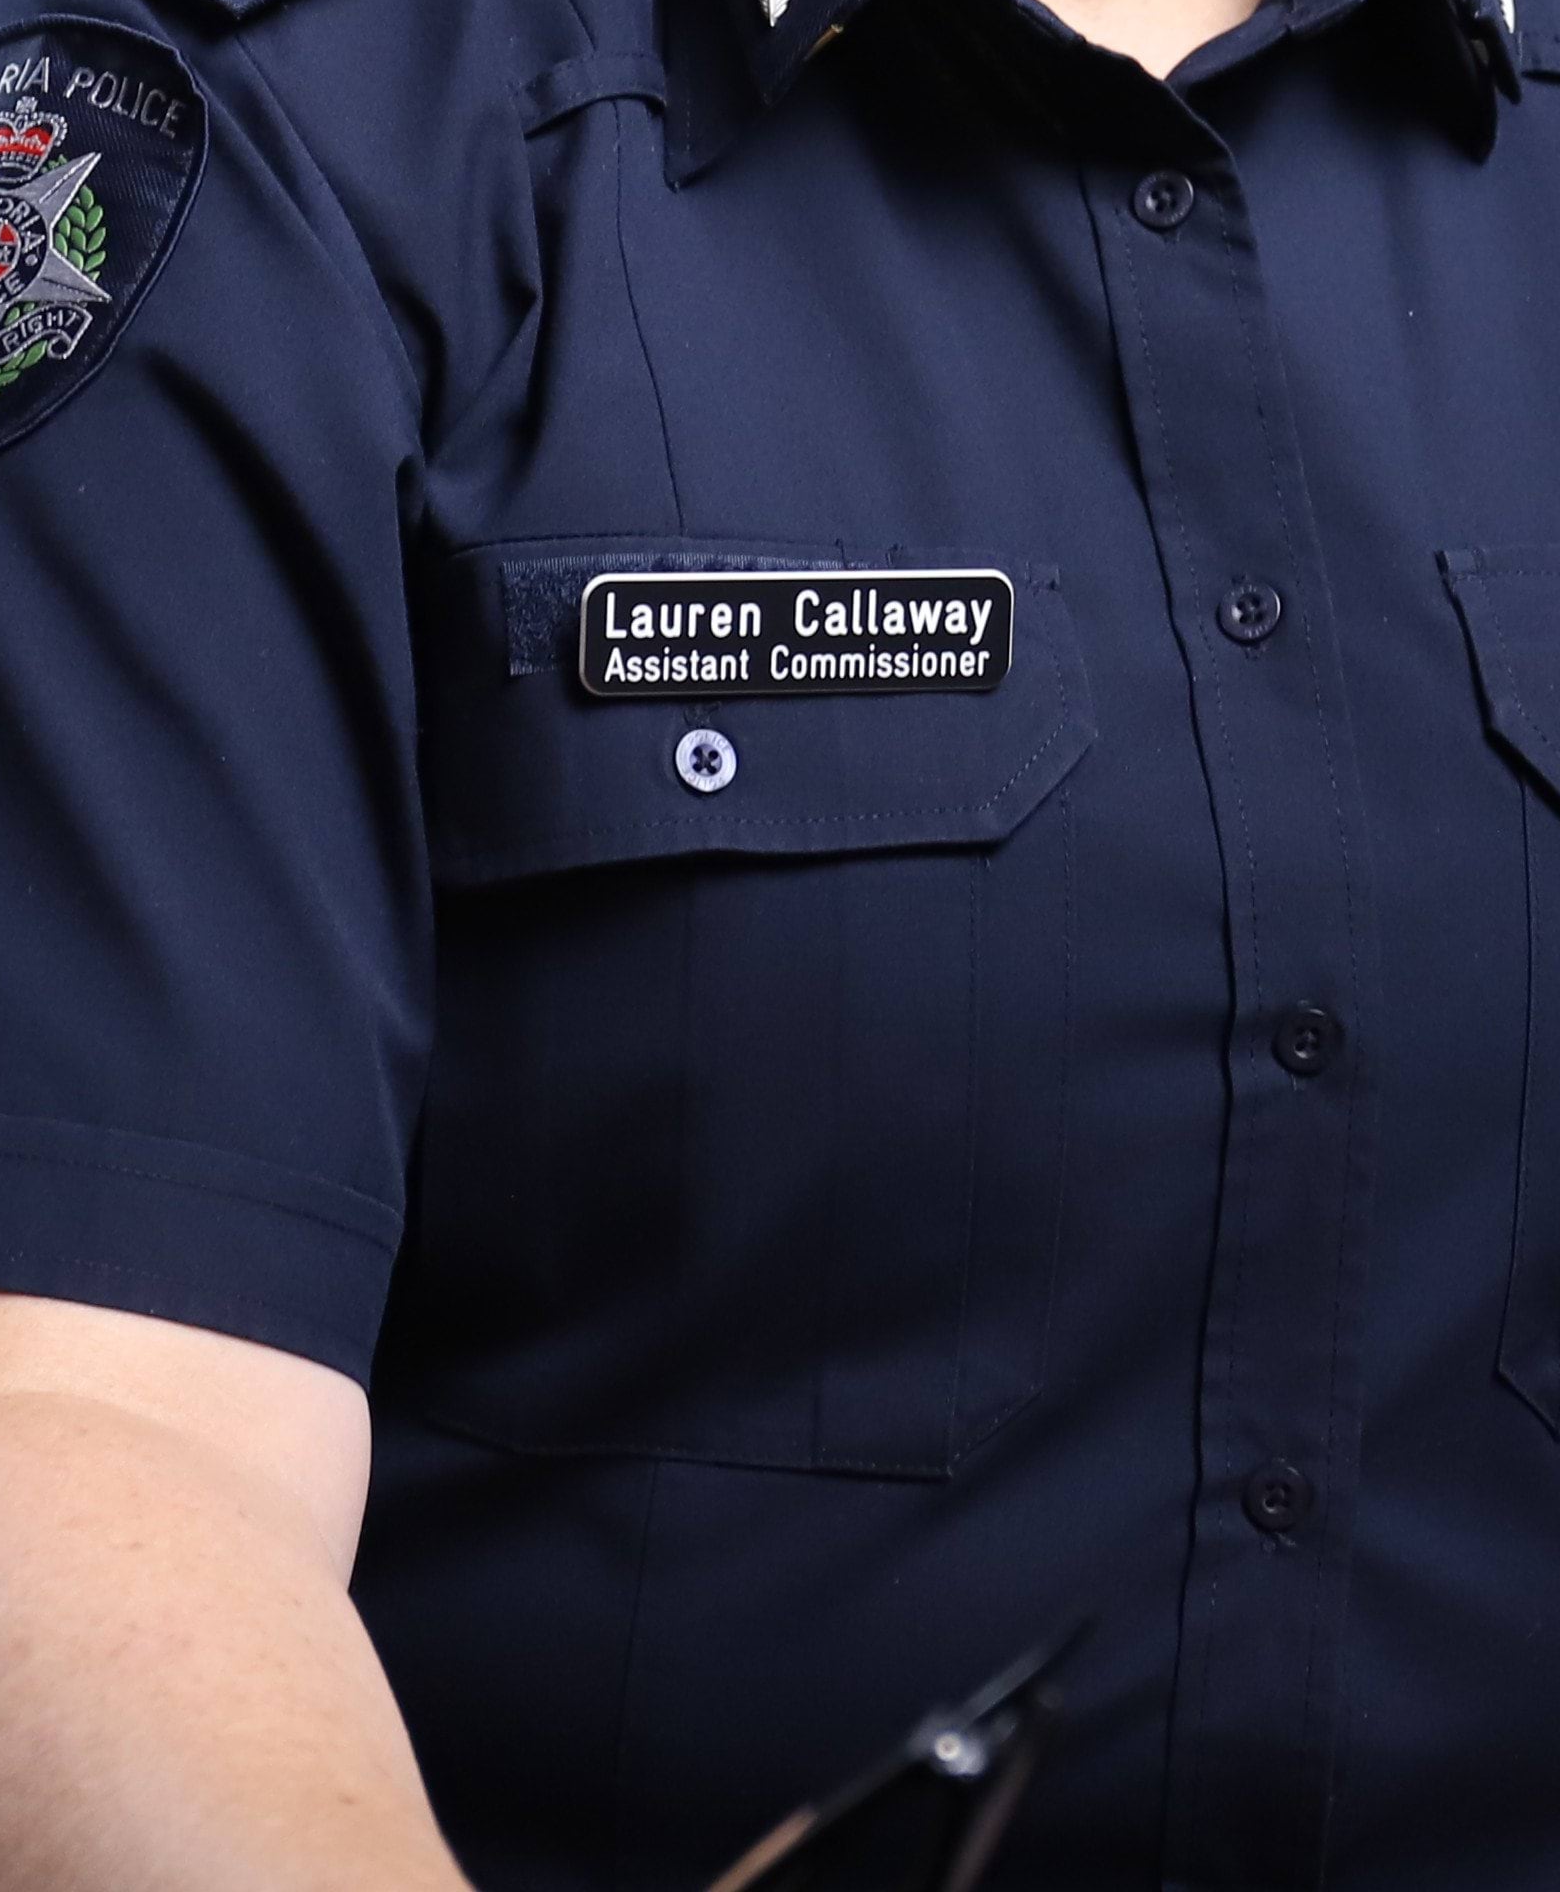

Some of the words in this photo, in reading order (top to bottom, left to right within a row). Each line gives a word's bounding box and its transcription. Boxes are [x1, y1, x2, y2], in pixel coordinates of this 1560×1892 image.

[64, 65, 188, 140] POLICE
[2, 309, 82, 354] RIGHT
[604, 591, 762, 640] Lauren
[793, 588, 993, 646] Callaway
[603, 645, 751, 684] Assistant
[769, 643, 991, 681] Commissioner
